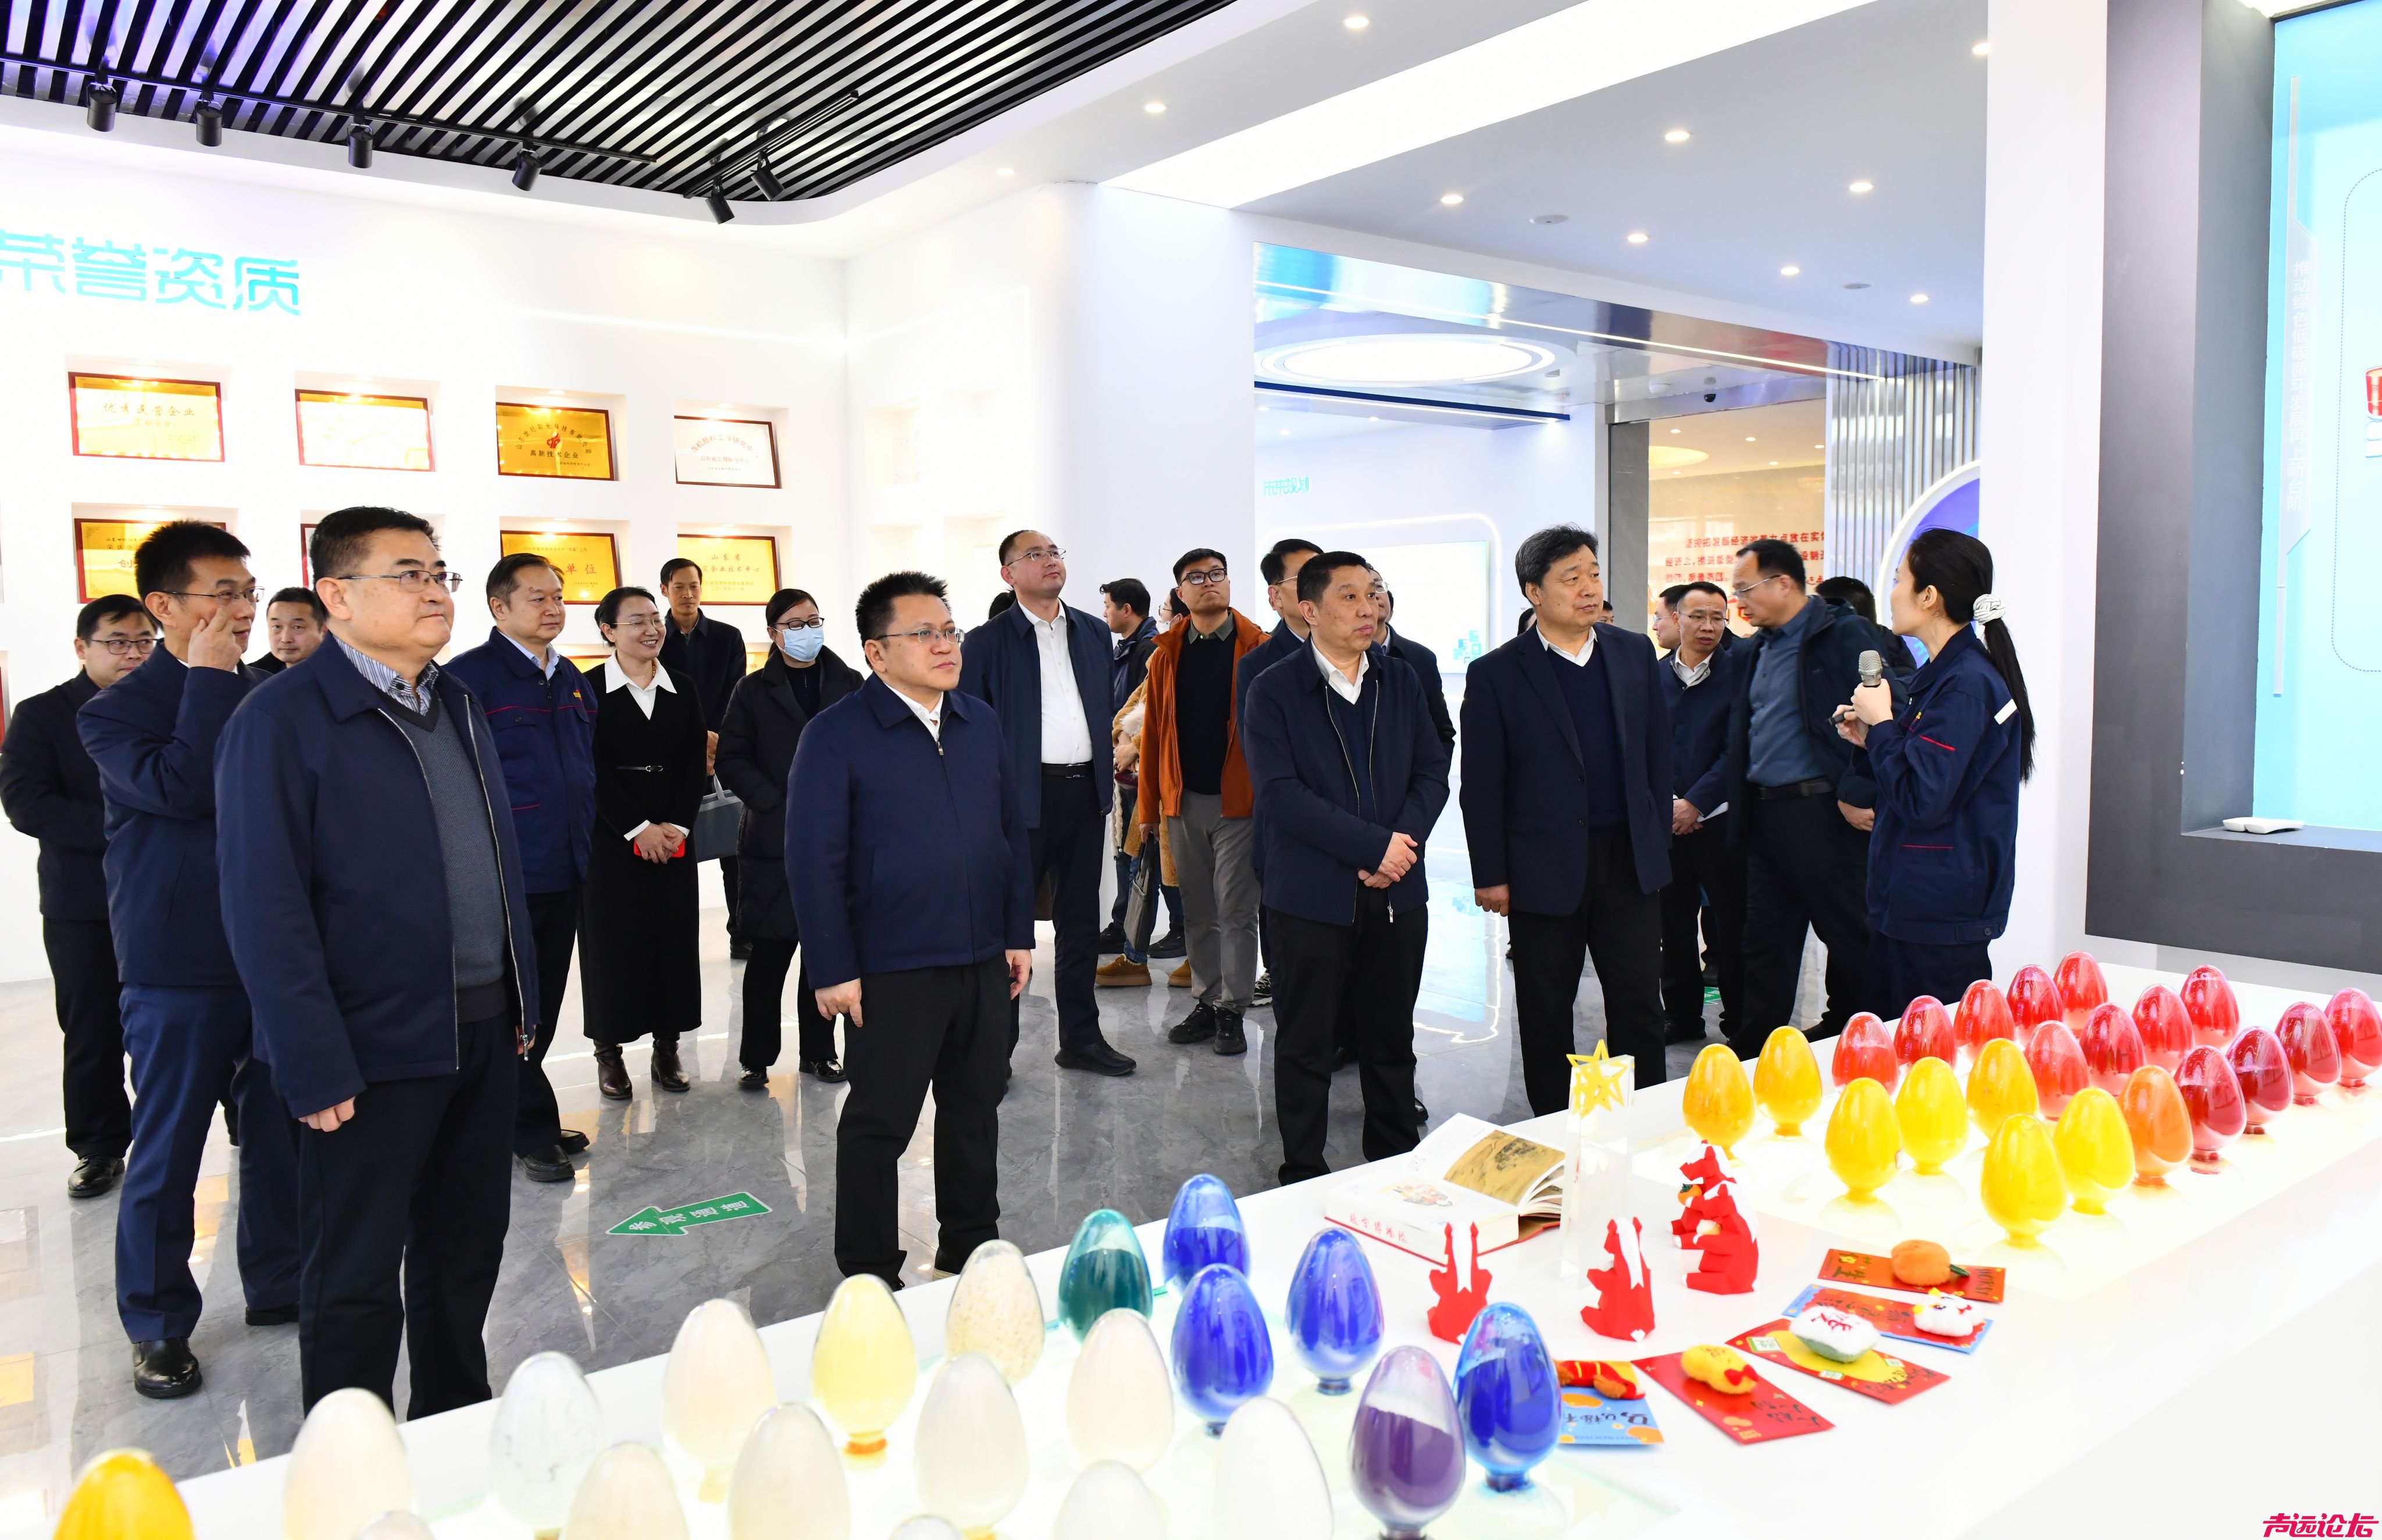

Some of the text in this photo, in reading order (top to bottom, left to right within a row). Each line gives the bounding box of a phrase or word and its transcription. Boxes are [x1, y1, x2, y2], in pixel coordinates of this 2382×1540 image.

[0, 229, 301, 316] 荣誉资质
[2286, 261, 2310, 512] 推动绿色低碳循环发展再上新台阶
[104, 402, 196, 417] 优秀民营企业
[530, 450, 579, 459] 高新技术企业
[1264, 475, 1310, 497] 未来规划
[711, 553, 740, 562] 山东省
[566, 563, 598, 576] 单位
[628, 1200, 750, 1232] 参观通道
